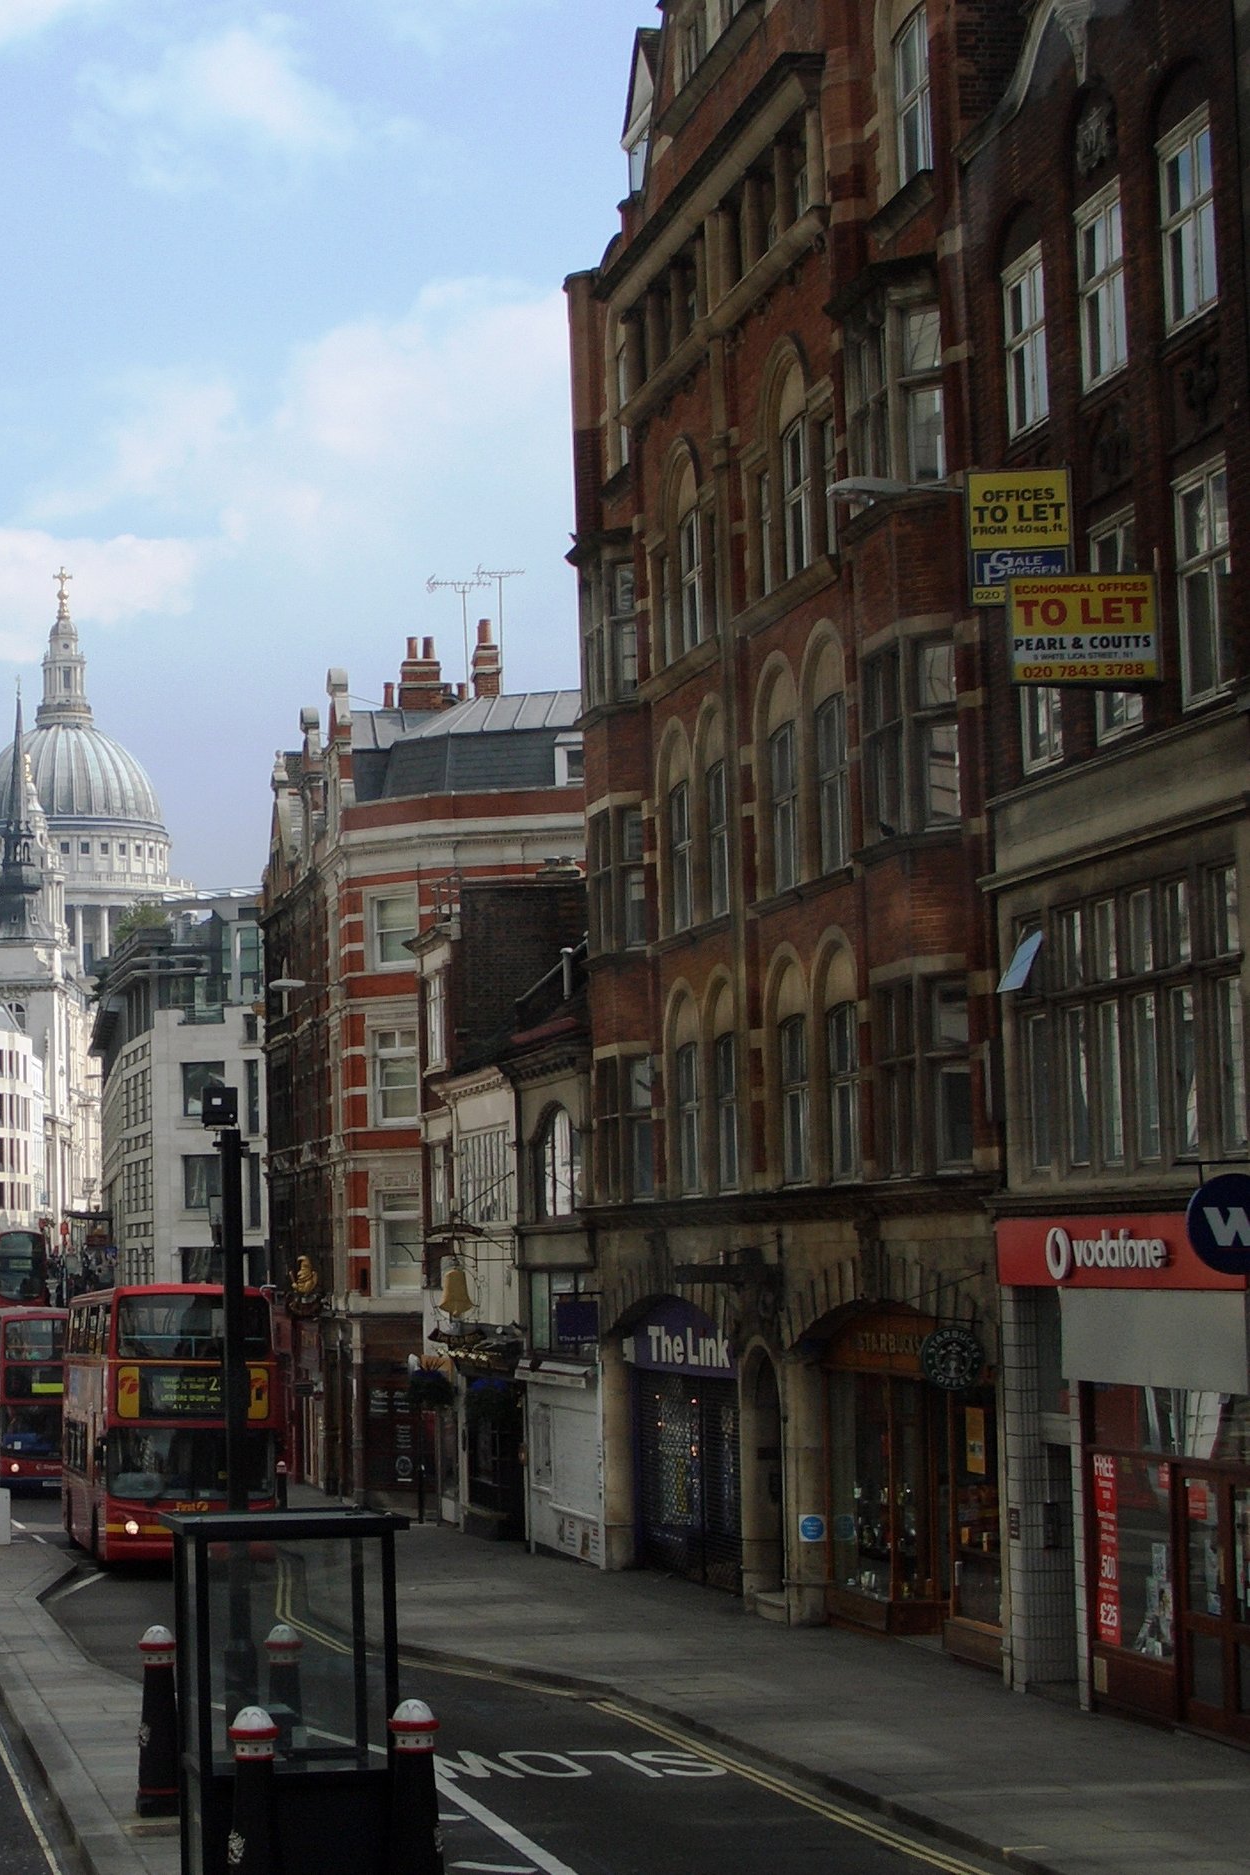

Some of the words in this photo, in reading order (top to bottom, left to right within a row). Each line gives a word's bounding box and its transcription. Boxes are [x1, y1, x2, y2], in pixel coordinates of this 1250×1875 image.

[982, 488, 1055, 503] OFFICES
[972, 505, 1008, 523] TO
[1018, 503, 1065, 522] LET
[973, 526, 1007, 535] FROM
[975, 591, 1000, 600] 020
[1014, 584, 1094, 595] ECONOMICAL
[1098, 582, 1148, 592] OFFICES
[1016, 599, 1068, 626] TO
[1080, 597, 1148, 625] LET
[1014, 637, 1066, 651] PEARL
[1072, 637, 1083, 649] &
[1089, 635, 1151, 649] COUTTS
[1023, 666, 1053, 678] 020
[1059, 664, 1100, 678] 7843
[1105, 663, 1145, 676] 3788
[1071, 1227, 1168, 1269] vodafone
[647, 1325, 684, 1364] The
[686, 1326, 731, 1369] Link
[928, 1330, 981, 1358] STARBUCKS
[931, 1368, 972, 1387] COFFEE
[1093, 1453, 1114, 1478] FREE
[174, 1502, 196, 1512] First
[1100, 1602, 1118, 1627] £25
[434, 1749, 728, 1779] SLOW
